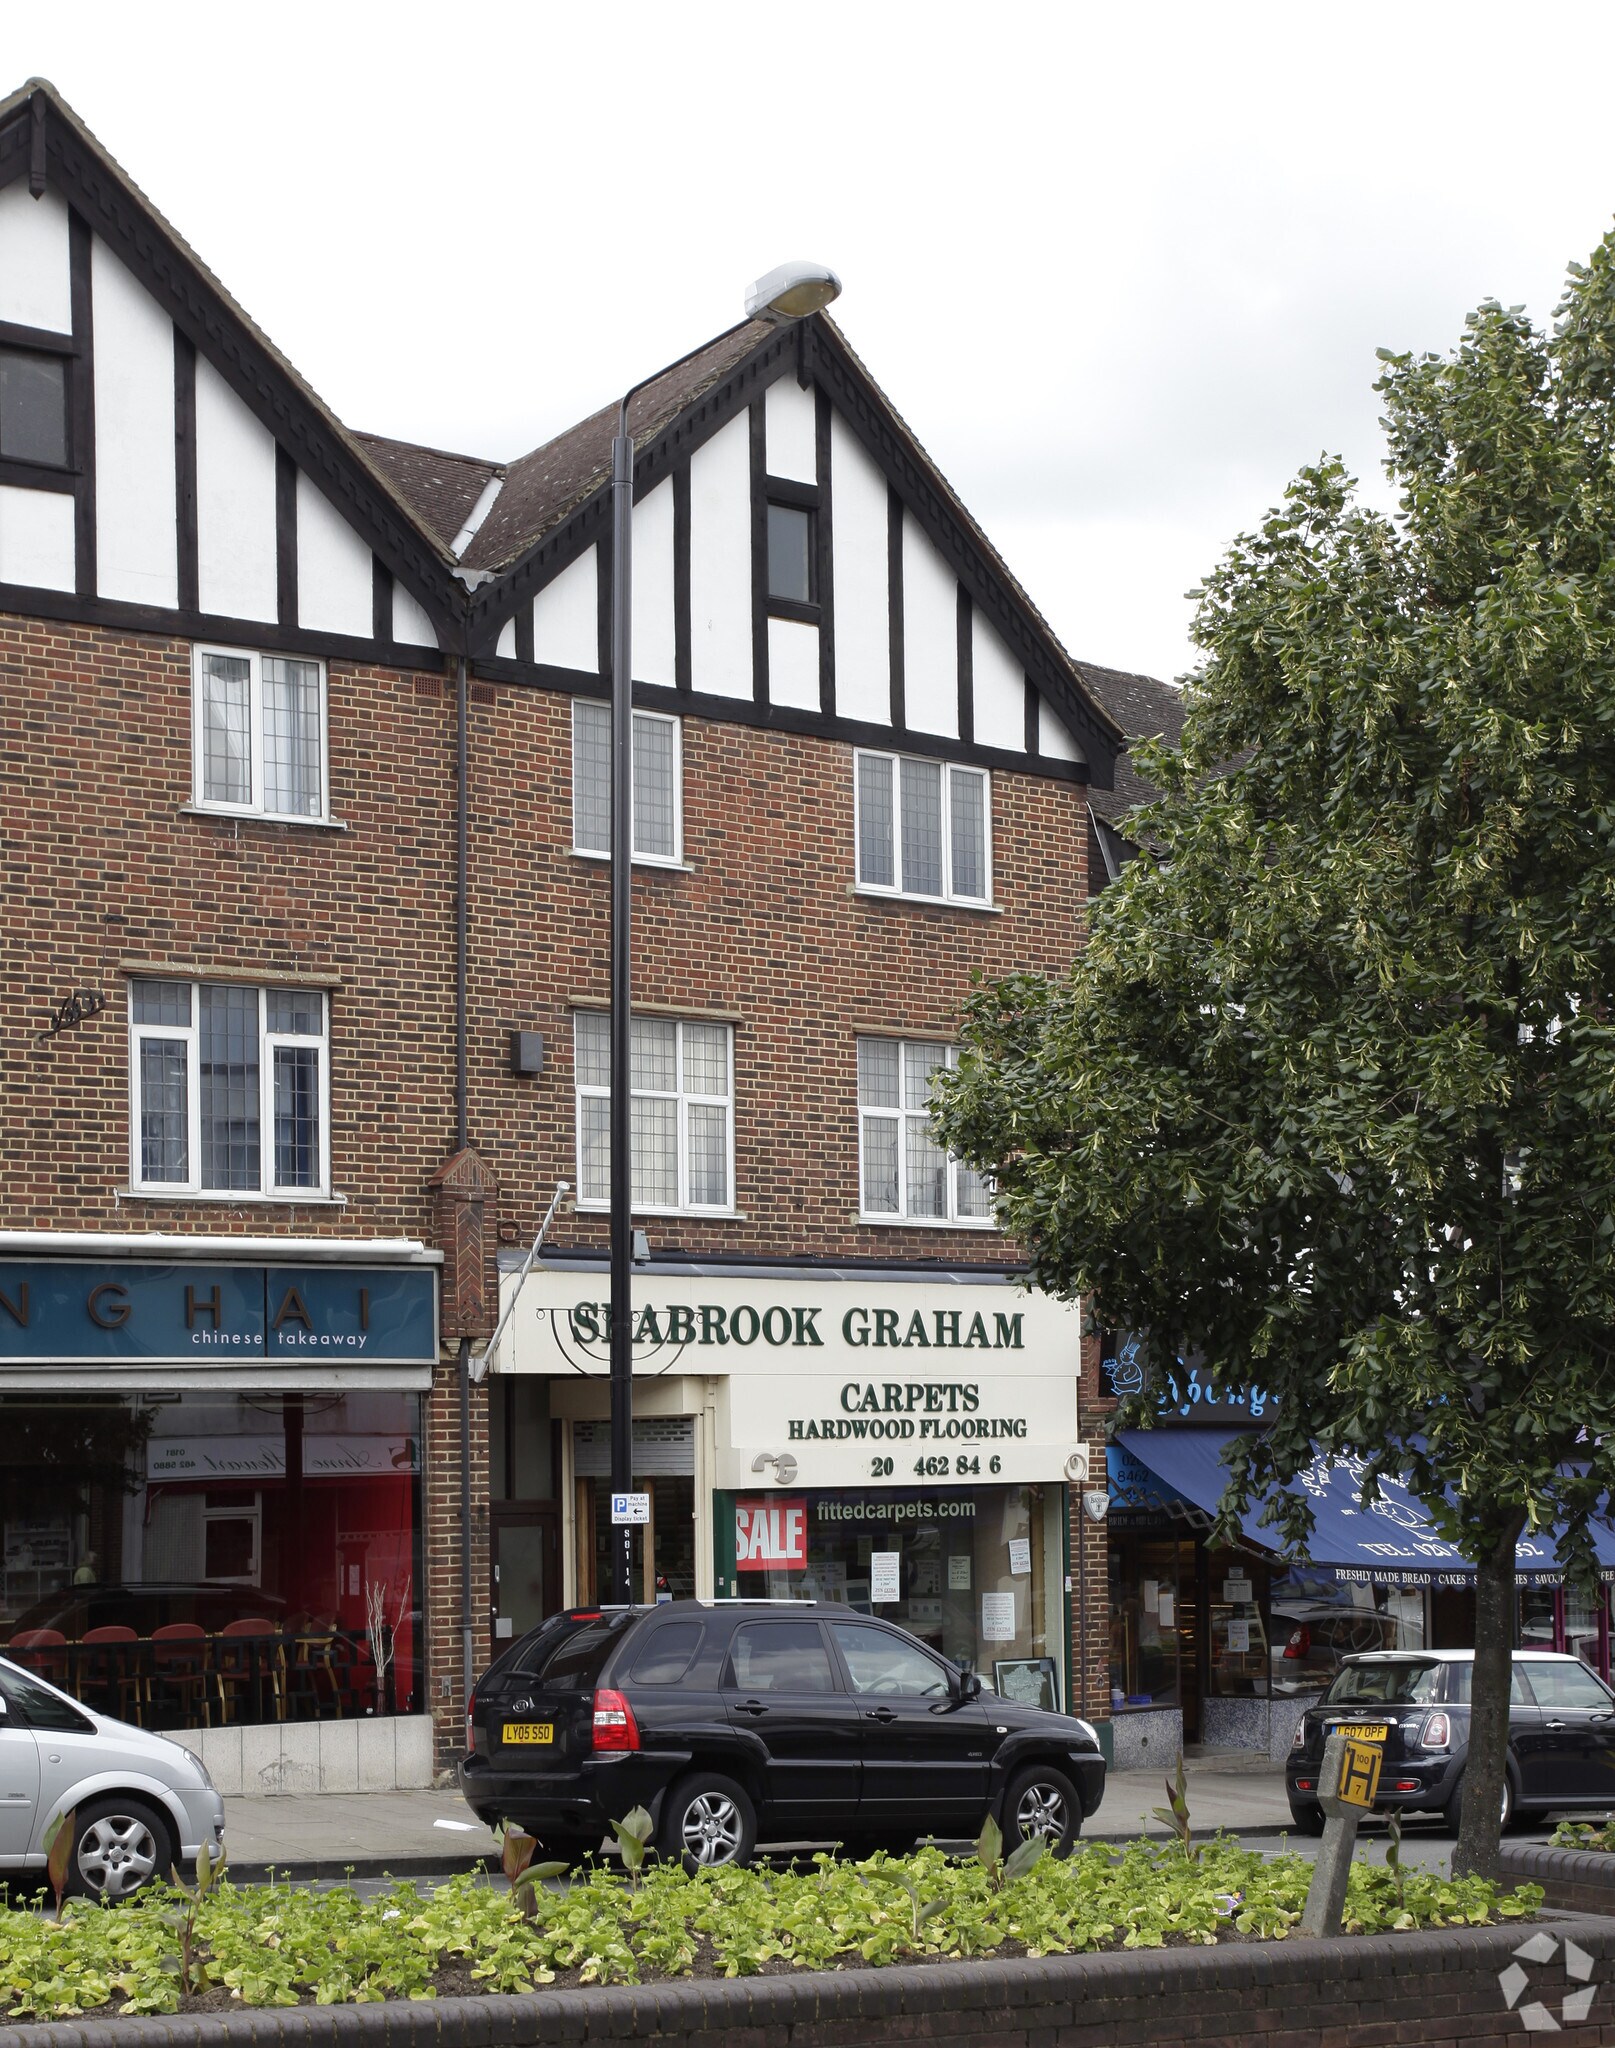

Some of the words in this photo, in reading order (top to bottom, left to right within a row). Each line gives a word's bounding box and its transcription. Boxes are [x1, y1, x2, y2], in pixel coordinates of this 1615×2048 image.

[842, 1307, 1025, 1349] GRAHAM
[192, 1330, 263, 1344] chinese
[278, 1330, 367, 1348] takeaway
[841, 1383, 980, 1413] CARPETS
[788, 1419, 914, 1440] HARDWOOD
[919, 1418, 1028, 1438] FLOORING
[817, 1501, 976, 1523] fittedcarpets.com
[736, 1509, 803, 1561] SALE
[1357, 1543, 1416, 1556] TEL:
[1412, 1543, 1452, 1556] 020
[1335, 1568, 1372, 1582] FRESHLY
[1374, 1571, 1400, 1583] MADE
[1402, 1572, 1431, 1584] BREAD
[1438, 1574, 1467, 1585] CAKES
[506, 1726, 530, 1740] LY05
[532, 1725, 550, 1739] SSO
[1364, 1727, 1384, 1737] OPF
[1356, 1754, 1369, 1764] 100
[1343, 1748, 1377, 1801] H
[1355, 1784, 1362, 1795] 7
